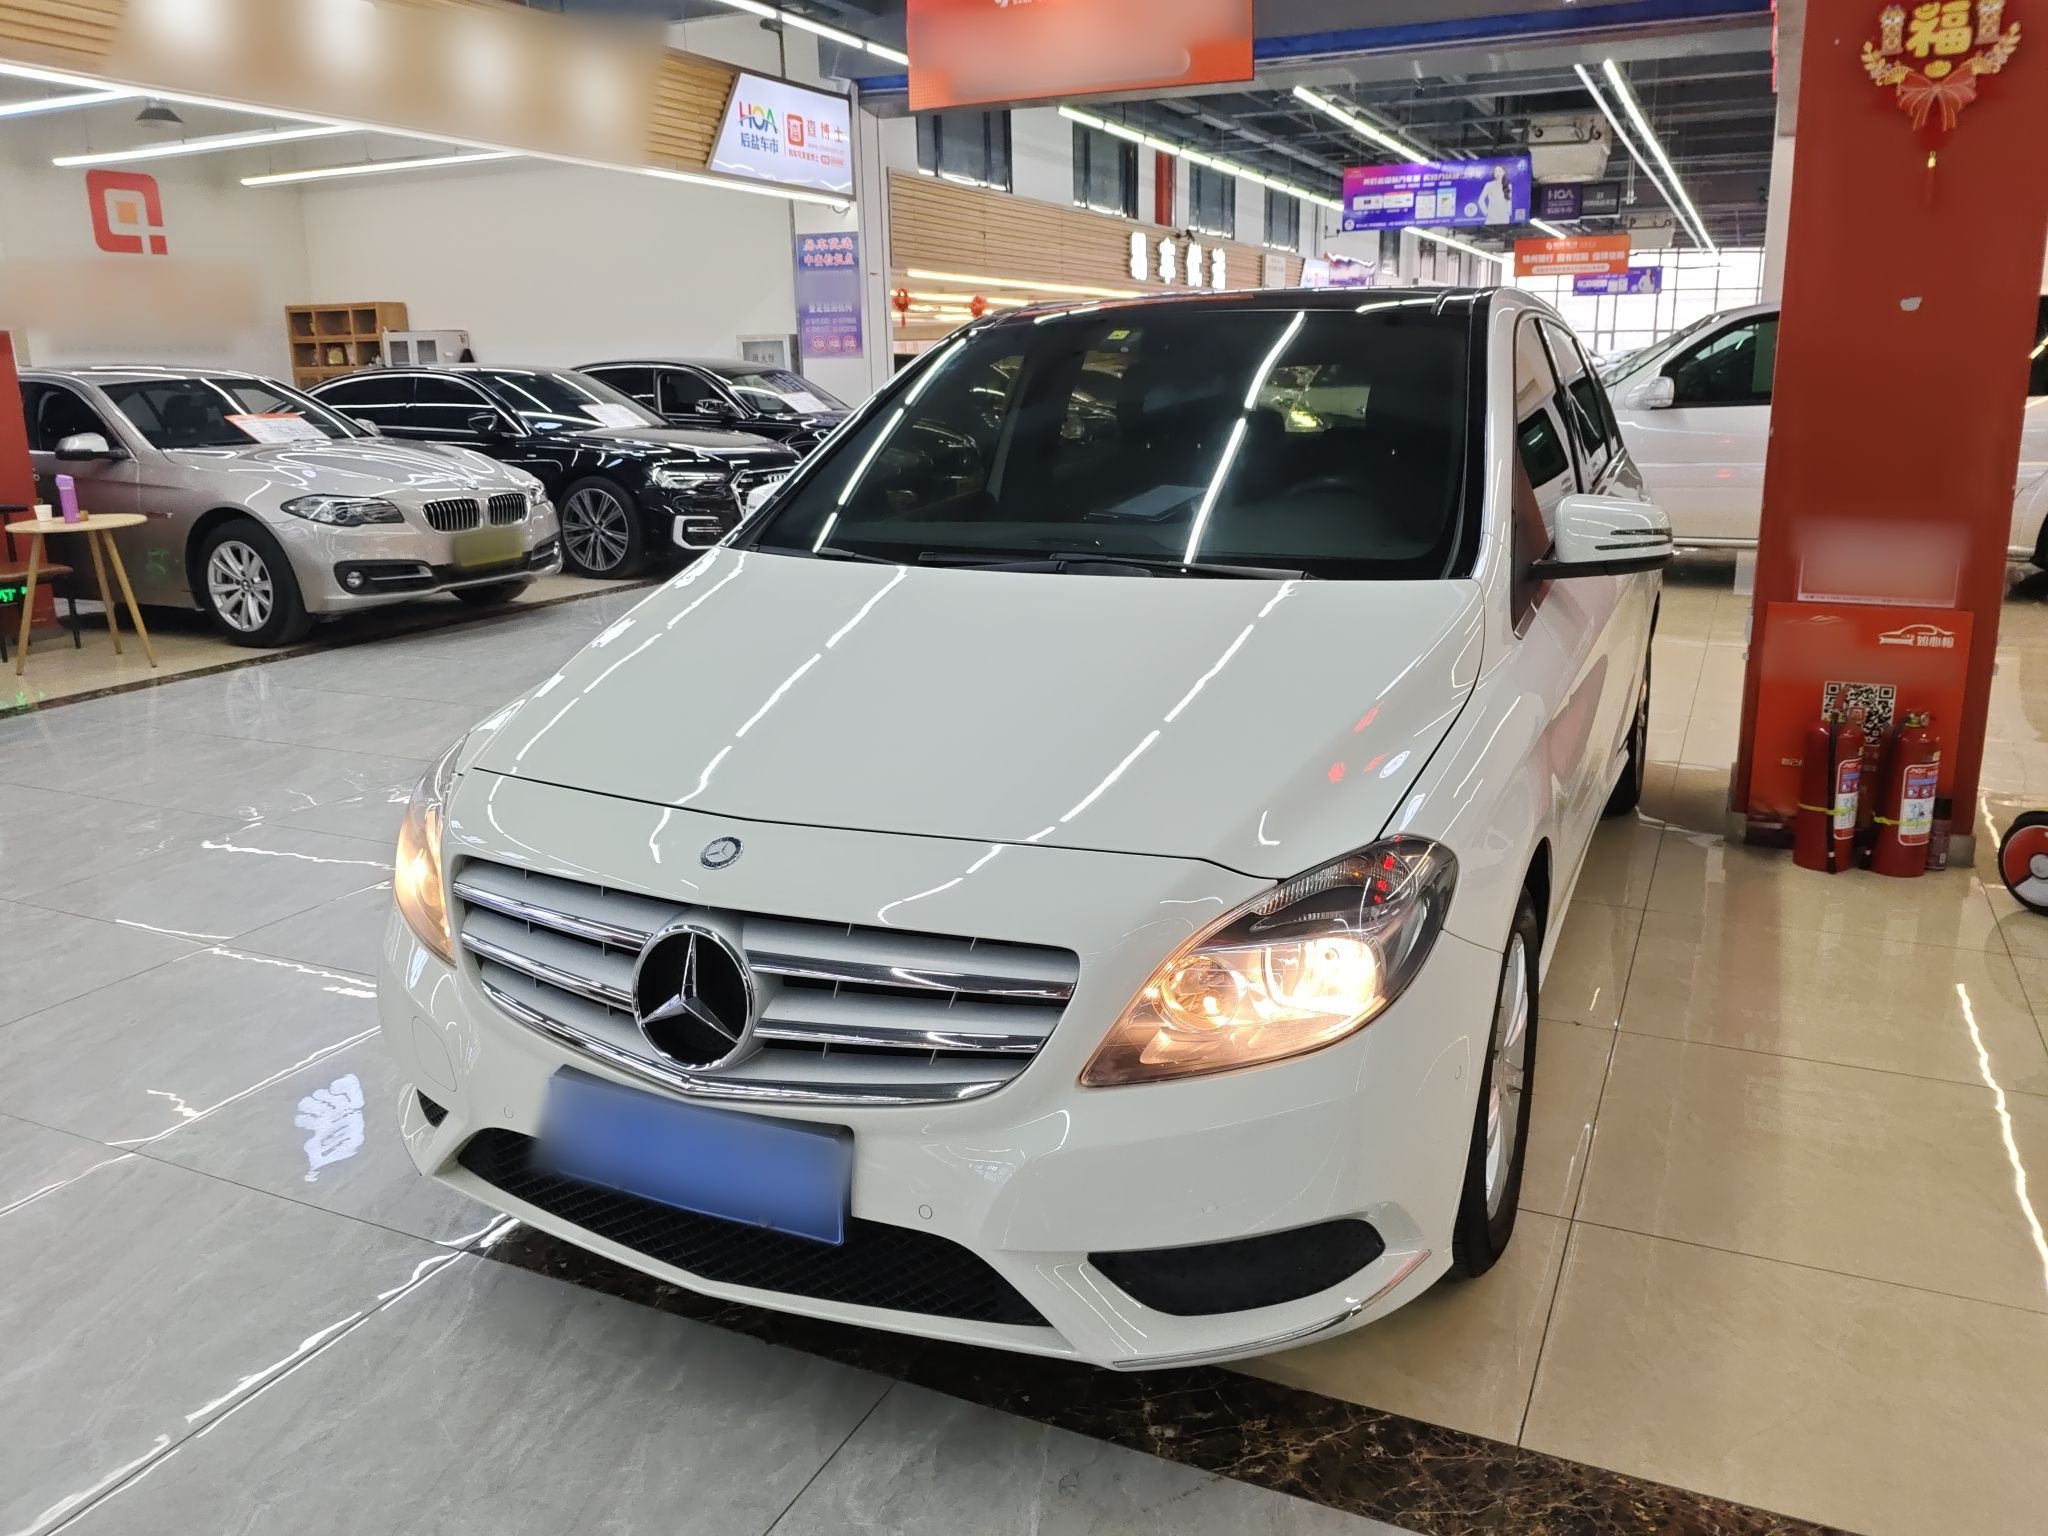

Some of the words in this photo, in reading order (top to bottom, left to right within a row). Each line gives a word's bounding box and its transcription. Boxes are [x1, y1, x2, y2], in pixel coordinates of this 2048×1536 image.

[1905, 1, 1972, 58] 福
[738, 101, 780, 134] HOA
[807, 119, 843, 143] 查博士
[740, 132, 779, 154] 后盐车市
